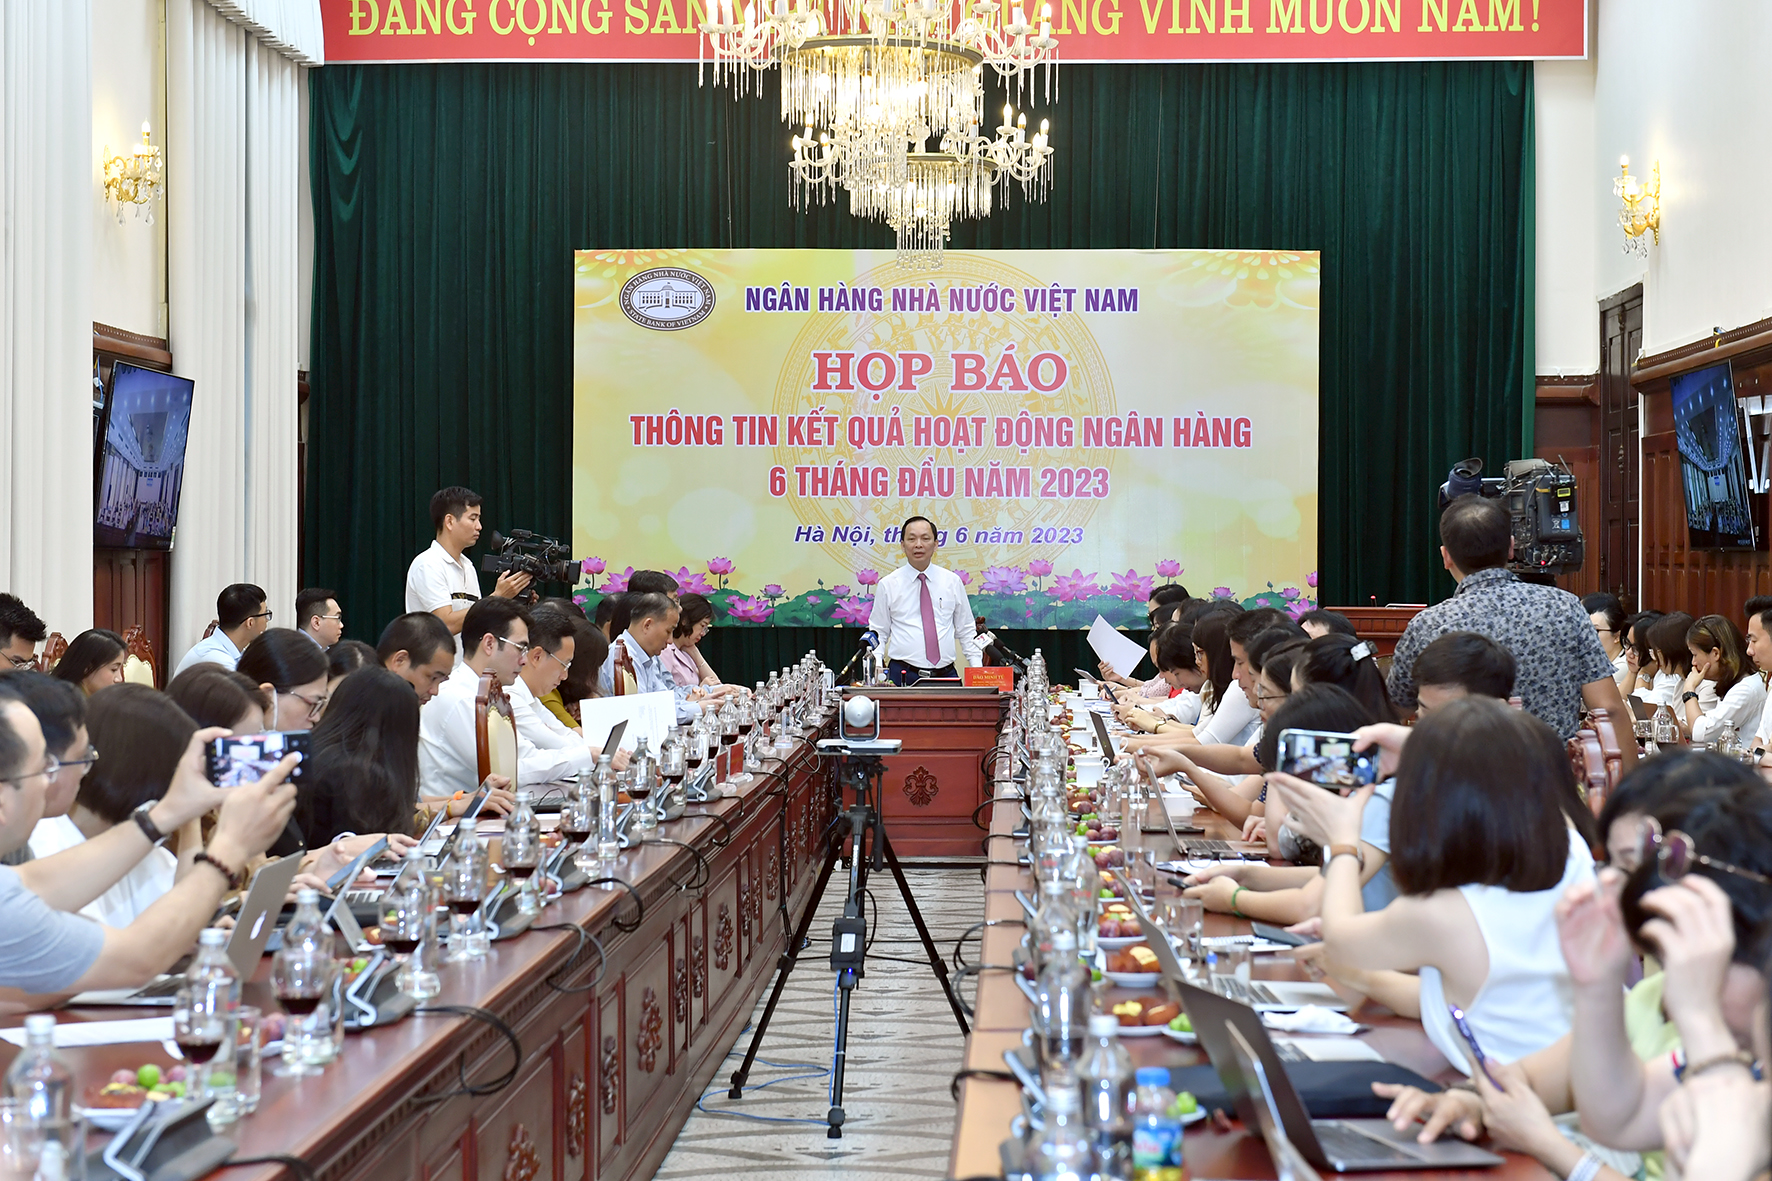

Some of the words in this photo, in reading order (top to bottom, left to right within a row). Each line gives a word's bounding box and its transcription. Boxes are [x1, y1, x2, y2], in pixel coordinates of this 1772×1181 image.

[1142, 0, 1254, 34] VINH
[746, 281, 808, 311] NGÂN
[818, 281, 882, 311] HÀNG
[892, 282, 940, 311] NHÀ
[949, 282, 1015, 313] NƯỚC
[1024, 282, 1077, 317] VIỆT
[1086, 288, 1138, 311] NAM
[629, 309, 647, 324] STATE
[646, 319, 666, 328] BANK
[666, 320, 676, 328] OF
[676, 309, 706, 327] VIETNAM
[813, 352, 932, 400] HỌP
[950, 343, 1067, 391] BÁO
[630, 409, 723, 446] THÔNG
[733, 416, 777, 445] TIN
[788, 406, 839, 446] KẾT
[848, 405, 904, 450] QUẢ
[915, 417, 986, 452] HOẠT
[995, 411, 1072, 452] ĐỘNG
[1085, 411, 1163, 447] NGÂN
[1174, 411, 1251, 447] HÀNG
[770, 466, 785, 497] 6
[796, 460, 888, 497] THÁNG
[898, 456, 955, 497] ĐẦU
[965, 463, 1030, 497] NĂM
[1041, 468, 1109, 498] 2023
[795, 525, 825, 543] Hà
[832, 525, 875, 548] Nội,
[955, 527, 967, 544] 6
[974, 526, 1023, 544] năm
[1031, 527, 1083, 544] 2023
